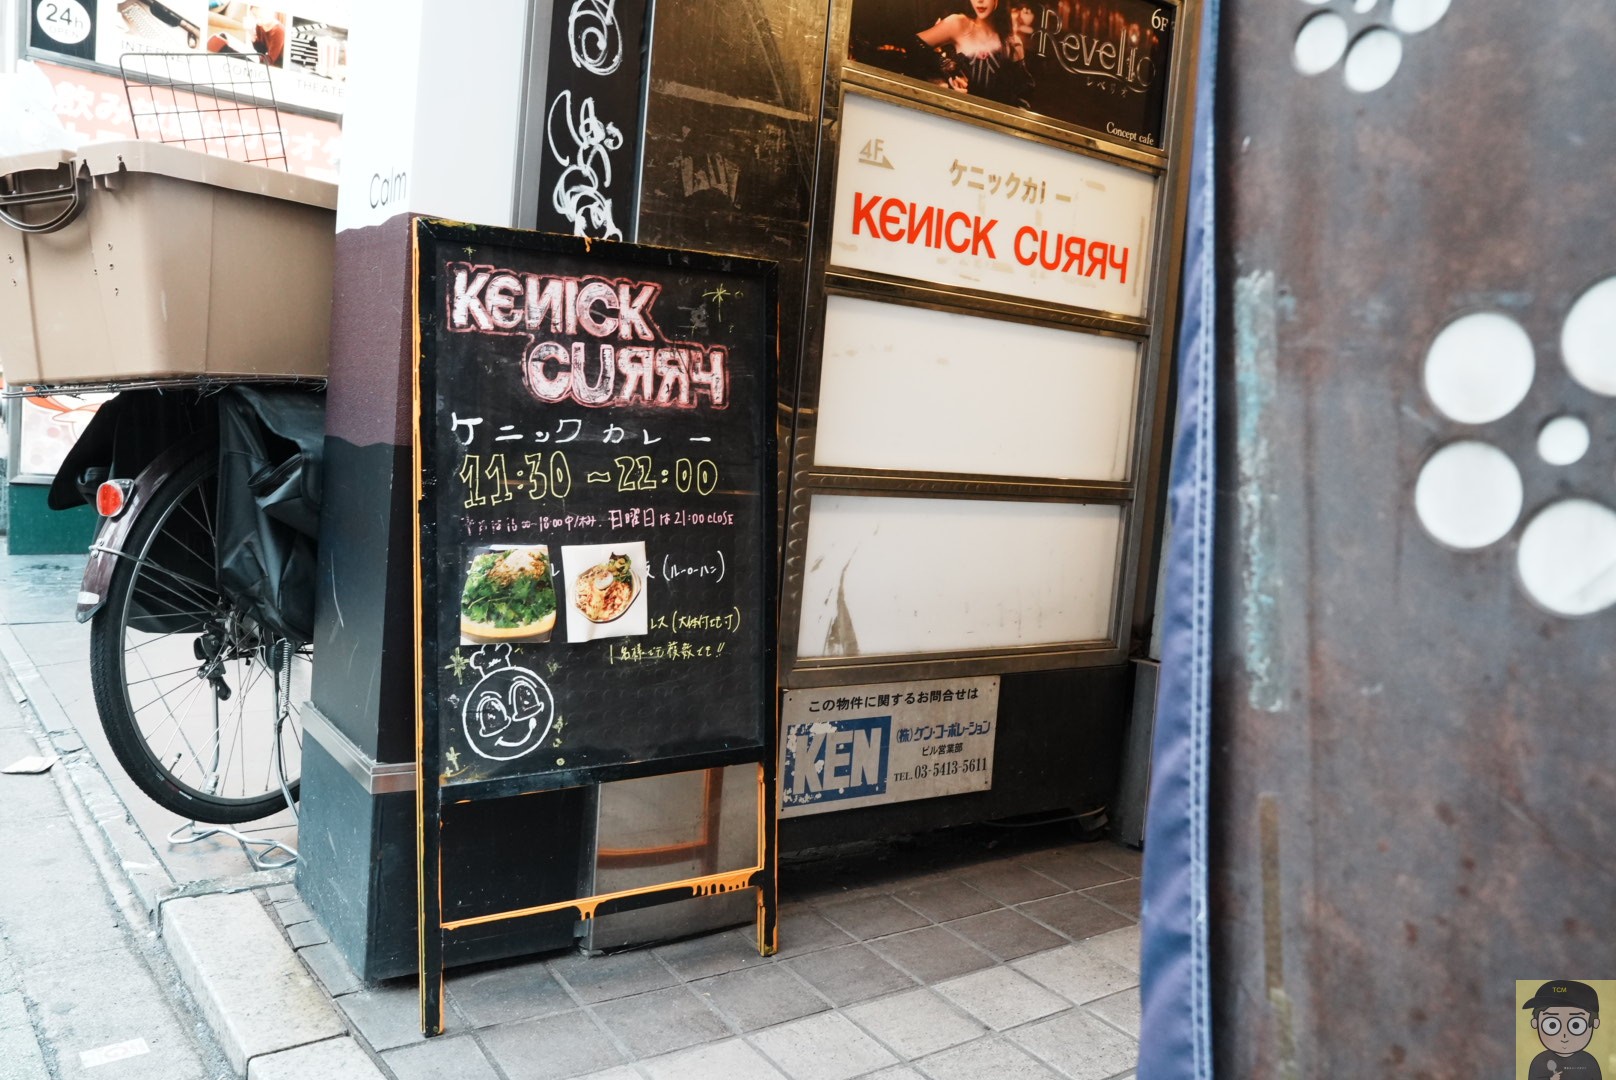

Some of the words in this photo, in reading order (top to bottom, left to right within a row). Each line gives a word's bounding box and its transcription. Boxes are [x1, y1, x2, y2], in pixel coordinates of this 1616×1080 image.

[1151, 8, 1170, 32] 6F
[1030, 4, 1156, 90] Revelio
[1106, 121, 1137, 142] Concept
[1138, 133, 1154, 145] cafe
[860, 138, 885, 160] 4F
[370, 166, 407, 209] Calm
[460, 451, 571, 508] 11:30
[809, 688, 978, 713] この物件に関するお問合せは
[793, 727, 882, 795] KEN
[922, 743, 963, 757] ビル営業部
[914, 758, 987, 780] 03-5413-5611
